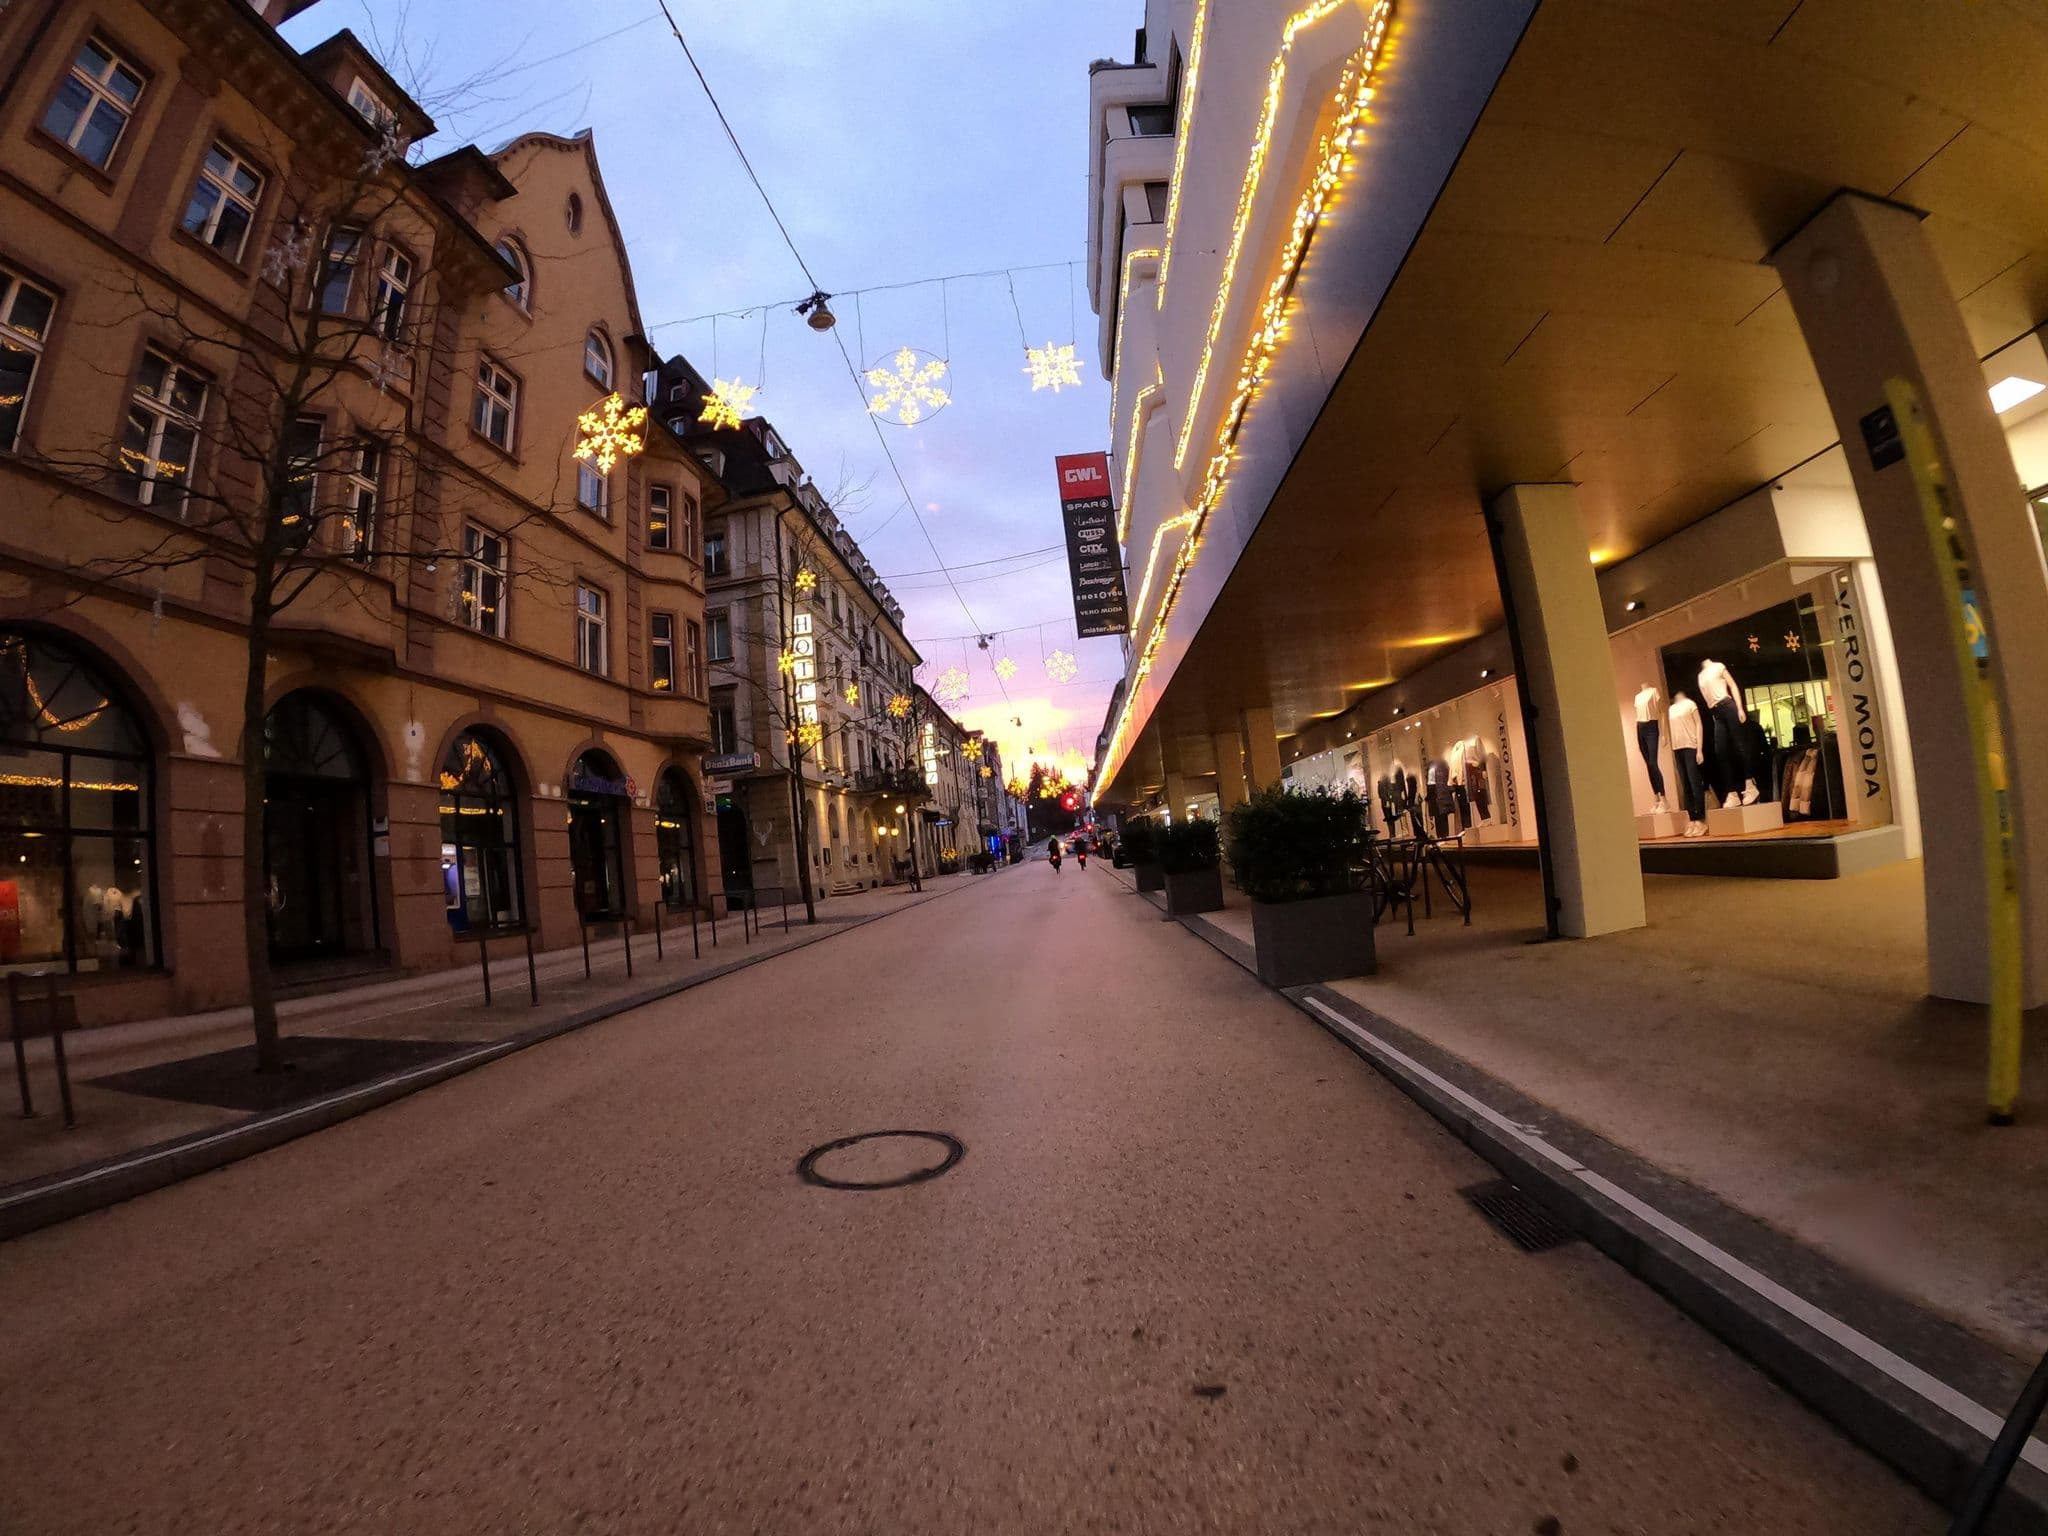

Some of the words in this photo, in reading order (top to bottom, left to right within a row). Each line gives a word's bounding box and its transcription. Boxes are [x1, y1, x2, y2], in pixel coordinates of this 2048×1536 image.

[1065, 466, 1102, 483] GWL
[1066, 501, 1099, 511] SPAR
[1080, 529, 1104, 538] FUSSL
[1080, 608, 1100, 616] VERO
[1101, 606, 1123, 614] MODA
[1834, 589, 1864, 684] VERO
[1852, 694, 1882, 798] MODA
[1498, 712, 1509, 765] VERO
[1505, 769, 1518, 827] MODA
